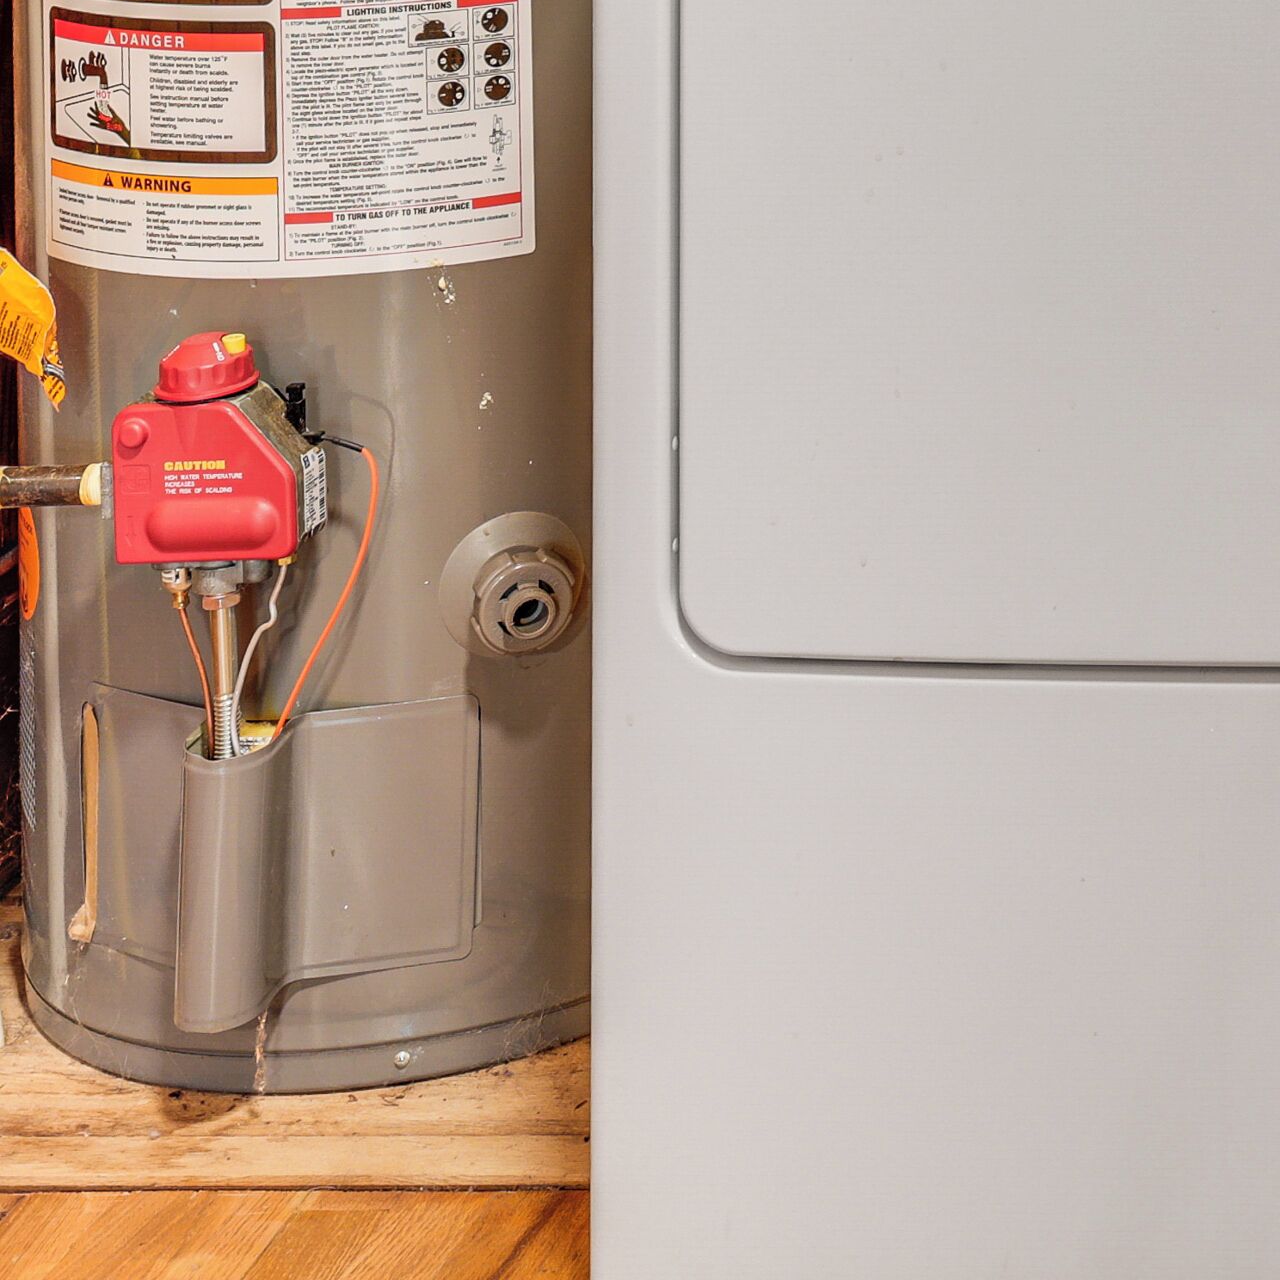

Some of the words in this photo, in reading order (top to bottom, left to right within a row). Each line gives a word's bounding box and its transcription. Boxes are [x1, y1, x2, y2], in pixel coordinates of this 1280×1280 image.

[347, 7, 386, 16] LIGHTING
[389, 1, 452, 13] INSTRUCTIONS
[119, 32, 185, 48] DANGER
[96, 90, 112, 99] HOT
[121, 176, 192, 193] WARNING
[348, 212, 367, 220] TURN
[368, 211, 384, 219] GAS
[385, 210, 399, 218] OFF
[401, 208, 411, 216] TO
[413, 206, 428, 215] THE
[429, 202, 470, 214] APPLIANCE
[164, 460, 225, 471] CAUTION
